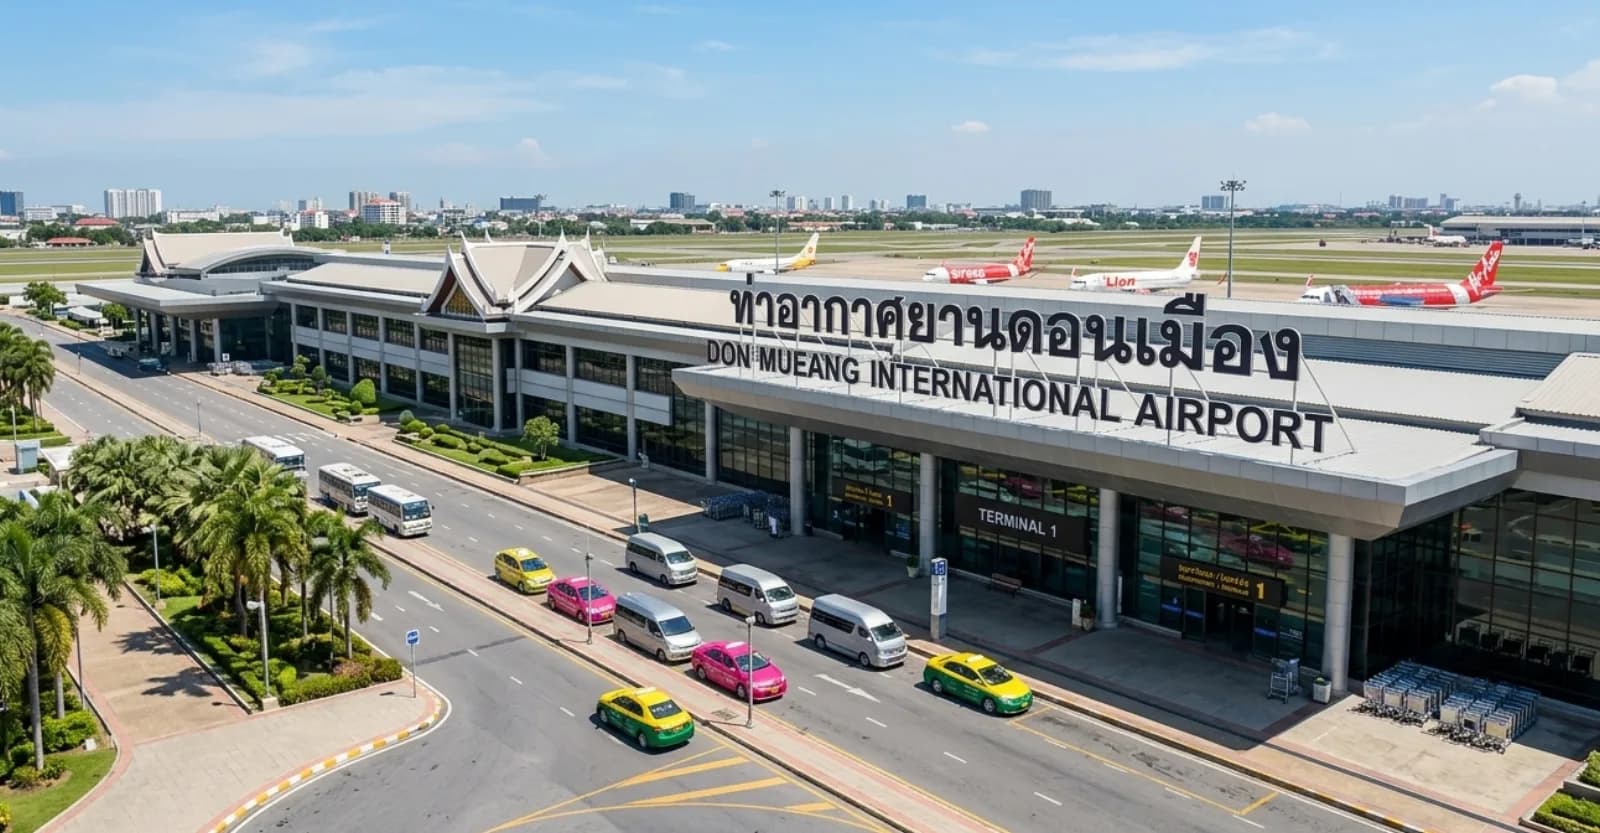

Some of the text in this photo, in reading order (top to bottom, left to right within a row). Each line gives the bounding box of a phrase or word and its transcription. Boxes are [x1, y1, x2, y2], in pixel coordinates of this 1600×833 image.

[730, 273, 1301, 381] ท่าอากาศยานดอนเมือง
[707, 340, 1334, 453] DON MUEANG INTERNATIONAL AIRPORT
[886, 495, 892, 508] 1
[978, 507, 1056, 538] TERMINAL 1
[1256, 582, 1265, 600] 1
